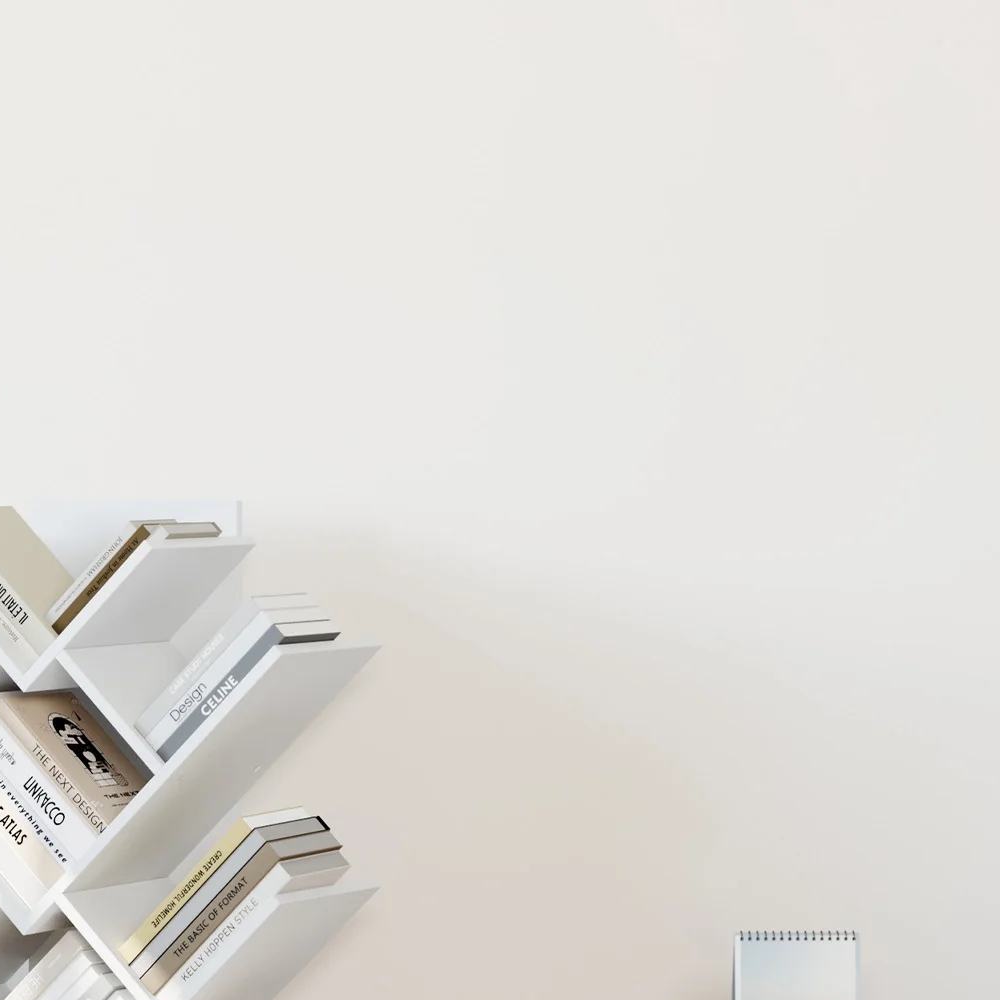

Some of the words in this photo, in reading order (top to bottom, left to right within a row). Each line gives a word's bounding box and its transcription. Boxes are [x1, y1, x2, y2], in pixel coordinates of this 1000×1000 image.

[18, 611, 29, 625] IL
[169, 683, 207, 722] Design
[200, 675, 239, 716] CELINE
[32, 743, 51, 768] THE
[49, 764, 74, 794] NEXT
[72, 792, 107, 835] DESIGN
[0, 814, 27, 846] ATLAS
[7, 791, 43, 836] everything
[43, 835, 54, 847] we
[53, 848, 67, 863] see
[203, 850, 223, 872] CREATE
[174, 869, 205, 903] WONDERFUL
[150, 900, 177, 928] HOMELIFE
[173, 944, 190, 958] THE
[187, 919, 210, 944] BASIC
[208, 907, 220, 921] OF
[218, 876, 248, 911] FORMAT
[180, 954, 205, 982] KELLY
[203, 922, 236, 957] HOPPEN
[234, 896, 259, 925] STYLE
